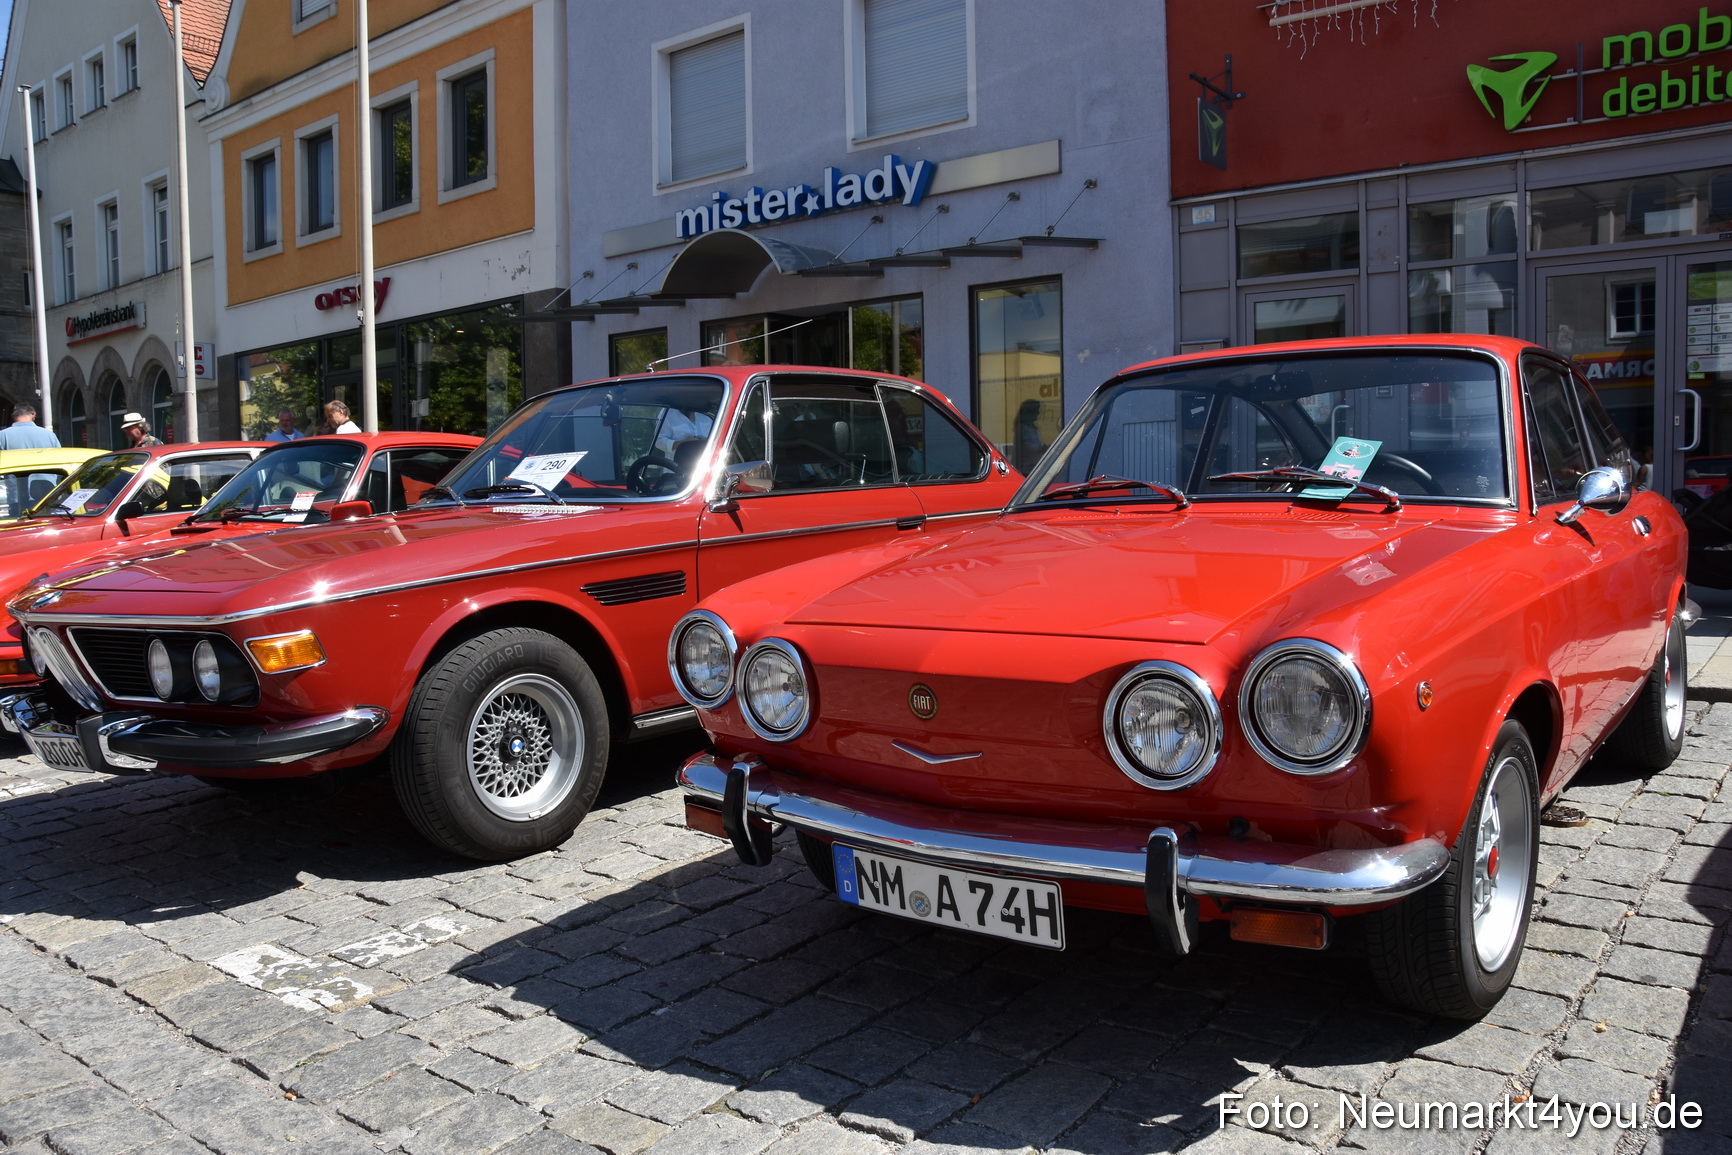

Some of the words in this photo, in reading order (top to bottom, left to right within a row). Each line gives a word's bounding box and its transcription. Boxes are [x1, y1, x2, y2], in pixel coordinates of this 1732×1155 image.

[1603, 65, 1732, 117] debit
[675, 184, 811, 240] mister
[824, 153, 932, 208] lady
[315, 277, 392, 316] orsy
[73, 300, 136, 339] HypoVereinsbank
[541, 459, 567, 471] 290
[463, 644, 524, 693] GIUGIARO
[913, 694, 931, 710] FIAT
[843, 879, 852, 893] D
[855, 856, 906, 910] NM
